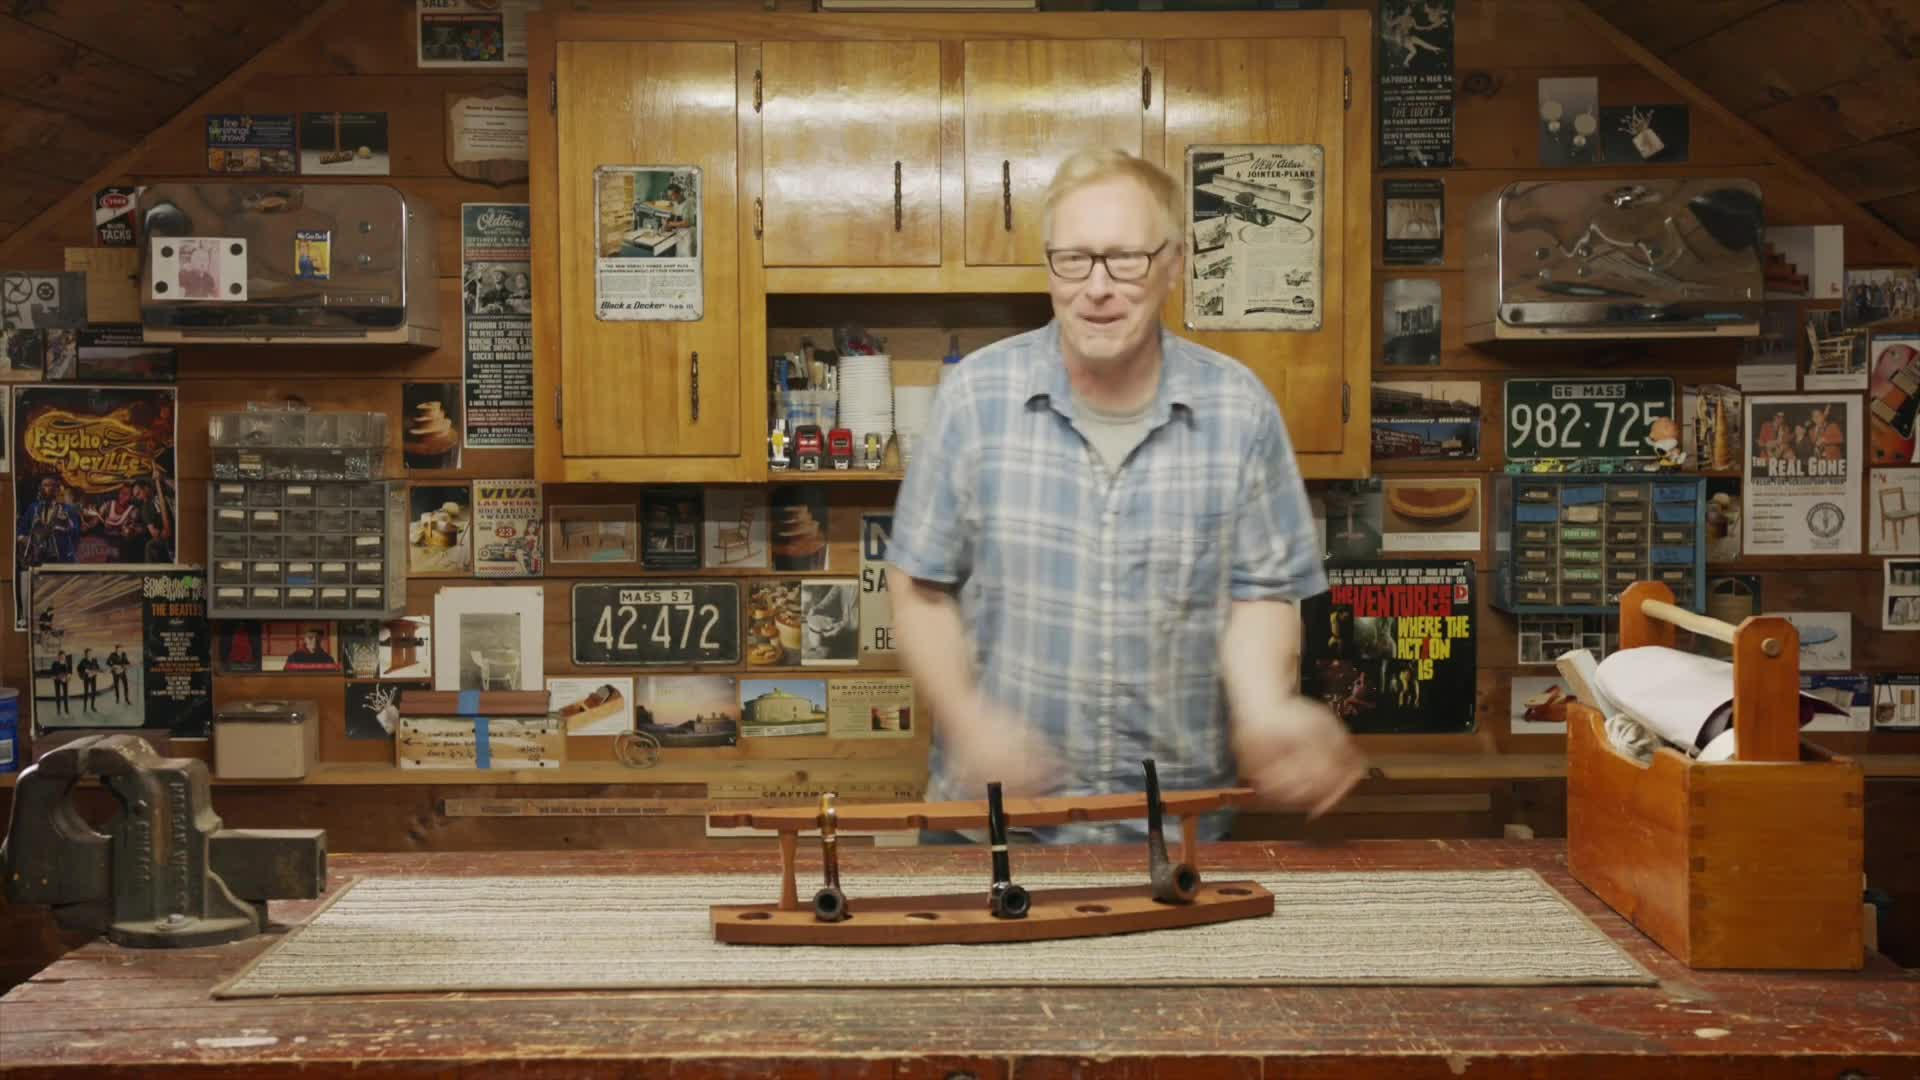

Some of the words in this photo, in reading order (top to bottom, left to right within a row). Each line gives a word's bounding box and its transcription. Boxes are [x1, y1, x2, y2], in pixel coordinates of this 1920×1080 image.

[600, 301, 624, 310] Black
[633, 301, 665, 310] Decker
[1583, 386, 1625, 396] MASS
[1768, 457, 1805, 476] REAL
[1808, 457, 1847, 476] GONE
[479, 488, 537, 499] VIVA
[498, 528, 513, 536] 23
[622, 592, 661, 602] MASS
[671, 591, 691, 601] 57
[1330, 585, 1354, 605] THE
[1353, 584, 1452, 618] VENTURES
[152, 603, 168, 616] THE
[1397, 616, 1443, 639] WHERE
[1446, 615, 1470, 639] THE
[1397, 637, 1451, 660] ACTION
[1417, 659, 1434, 681] IS
